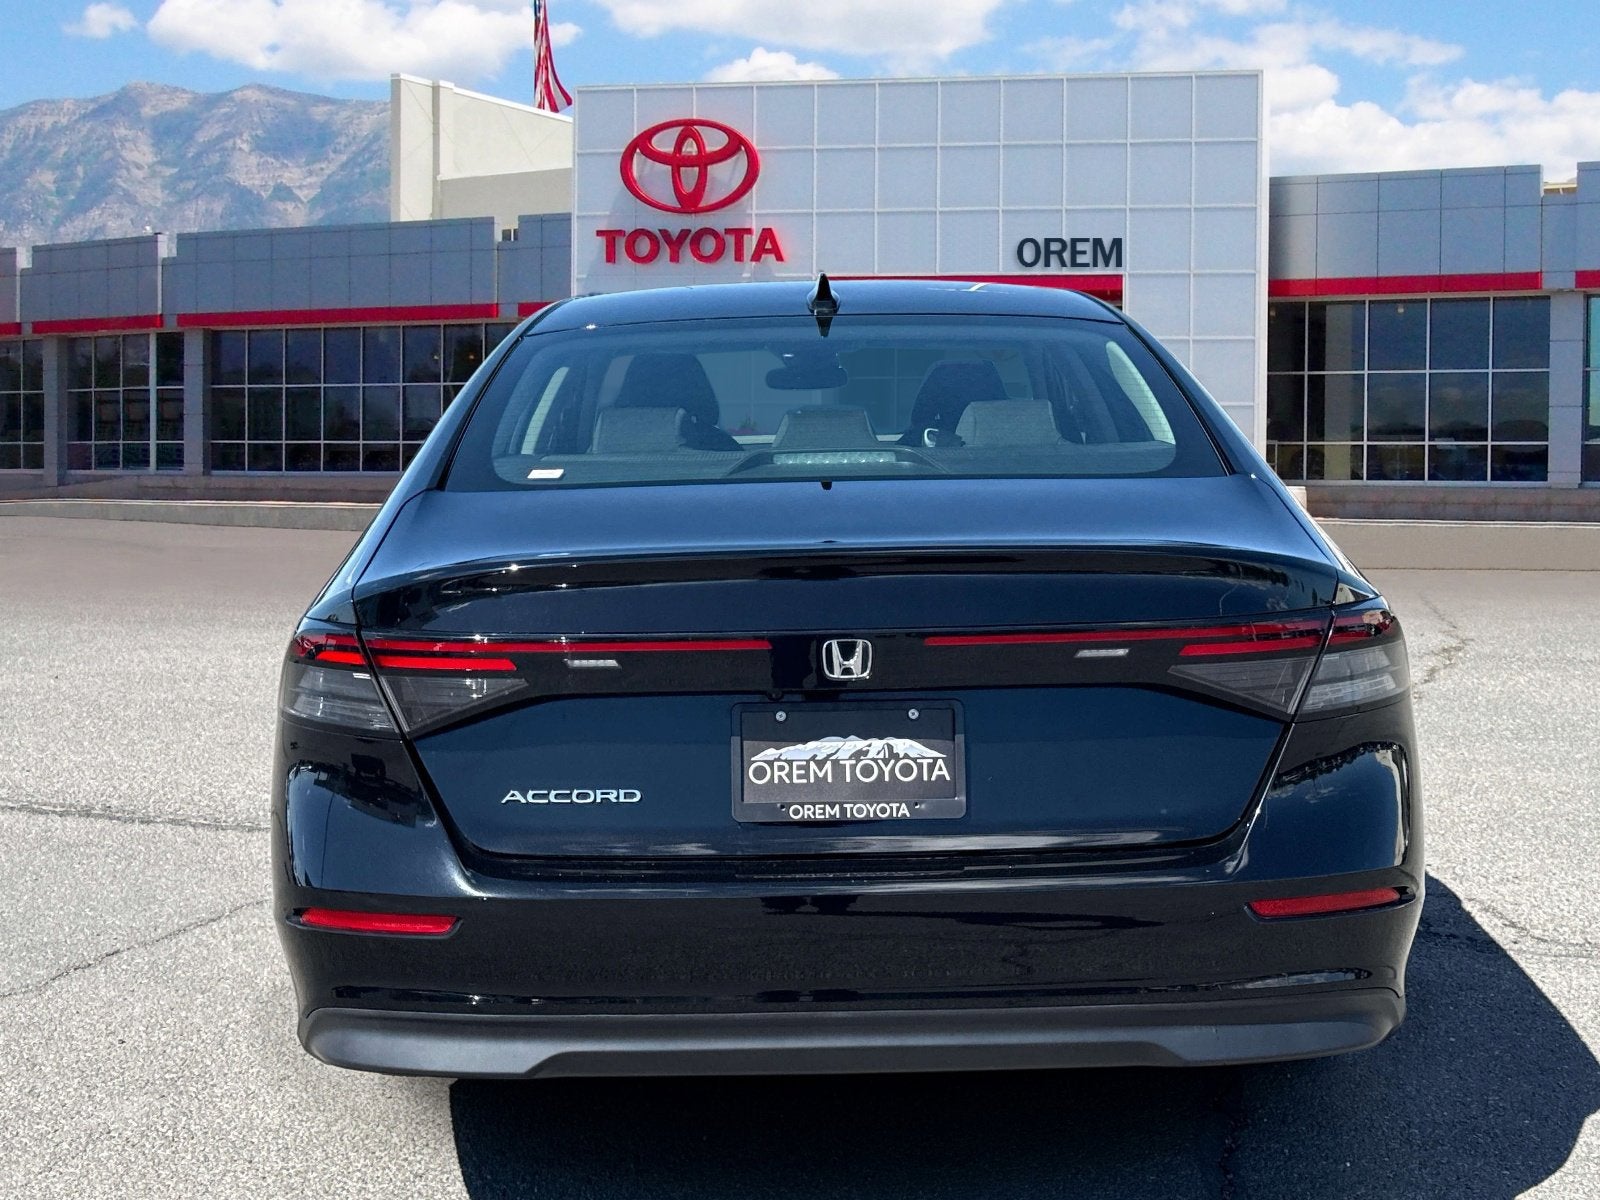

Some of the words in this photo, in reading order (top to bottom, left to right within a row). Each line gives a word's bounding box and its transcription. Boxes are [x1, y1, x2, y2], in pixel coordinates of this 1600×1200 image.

[596, 227, 785, 264] TOYOTA
[1016, 237, 1123, 268] OREM
[748, 760, 833, 784] OREM
[839, 758, 951, 783] TOYOTA
[501, 788, 642, 804] ACCORD
[788, 804, 840, 819] OREM
[843, 802, 911, 818] TOYOTA
